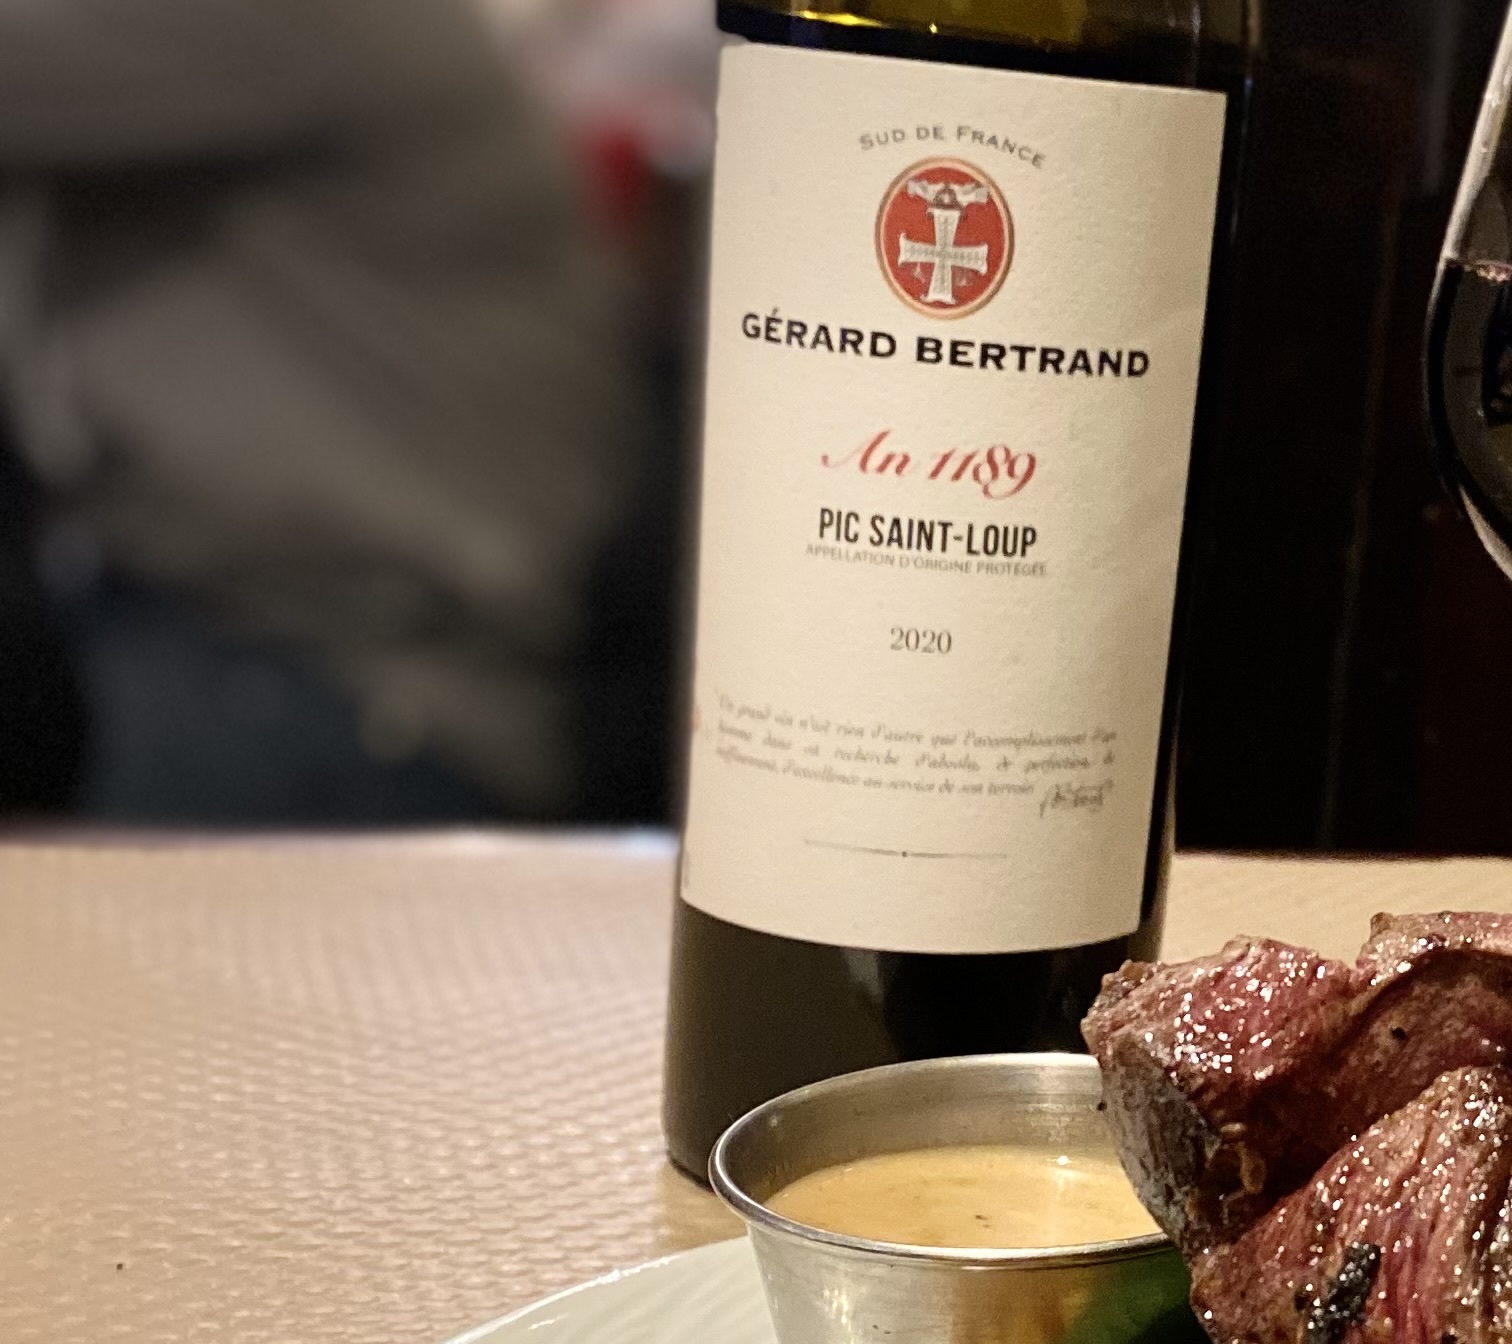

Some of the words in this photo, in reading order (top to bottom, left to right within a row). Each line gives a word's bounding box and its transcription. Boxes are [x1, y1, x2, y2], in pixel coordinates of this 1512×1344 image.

[859, 129, 906, 151] SUD
[915, 125, 945, 141] DE
[956, 125, 1046, 169] FRANCE
[741, 308, 897, 358] GÉRARD
[915, 335, 1151, 379] BERTRAND
[821, 429, 911, 476] An
[928, 444, 1037, 500] 1189
[806, 544, 895, 567] APPELLATION
[818, 507, 860, 544] PIC
[869, 514, 1038, 559] SAINT-LOUP
[890, 627, 953, 654] 2020
